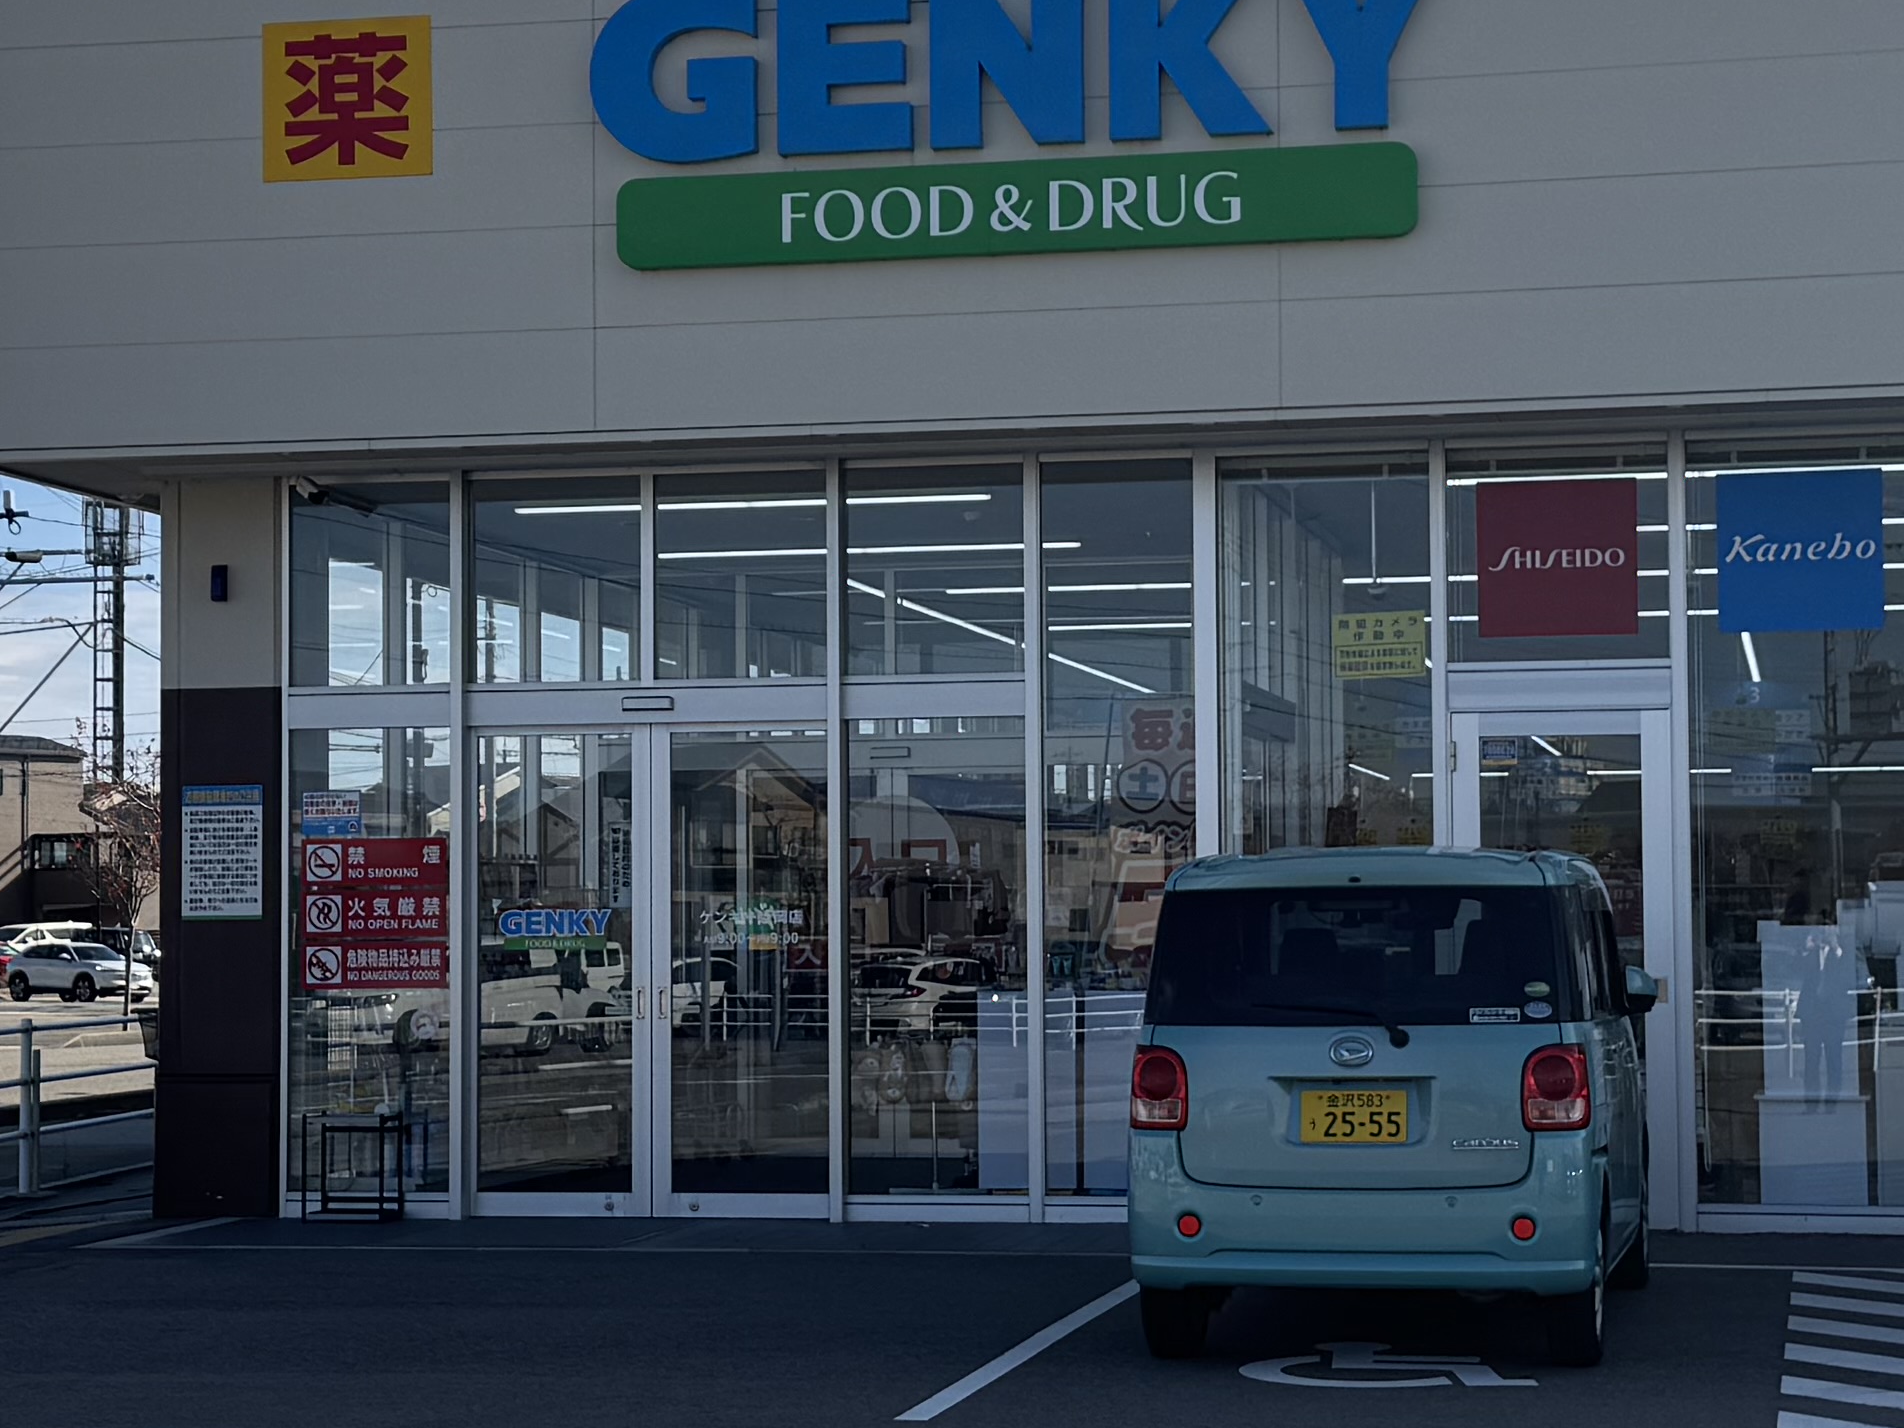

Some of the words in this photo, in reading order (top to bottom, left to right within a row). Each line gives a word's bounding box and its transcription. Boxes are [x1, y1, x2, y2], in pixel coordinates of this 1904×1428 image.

[284, 34, 411, 167] 薬
[1724, 533, 1878, 565] Kanebo
[1488, 546, 1626, 573] SHISEIDO
[1749, 686, 1761, 704] 3
[348, 846, 441, 864] 禁煙
[348, 868, 364, 878] NO
[368, 868, 419, 878] SMOKING
[348, 897, 441, 916] 火気厳禁
[348, 919, 364, 929] NO
[368, 919, 398, 929] OPEN
[402, 919, 439, 929] FLAME
[499, 909, 612, 936] GENKY
[348, 971, 359, 980] NO
[361, 971, 410, 980] DANGEROUS
[412, 971, 440, 980] GOODS
[1326, 1093, 1384, 1108] 金沢583
[1323, 1111, 1402, 1138] 25-55
